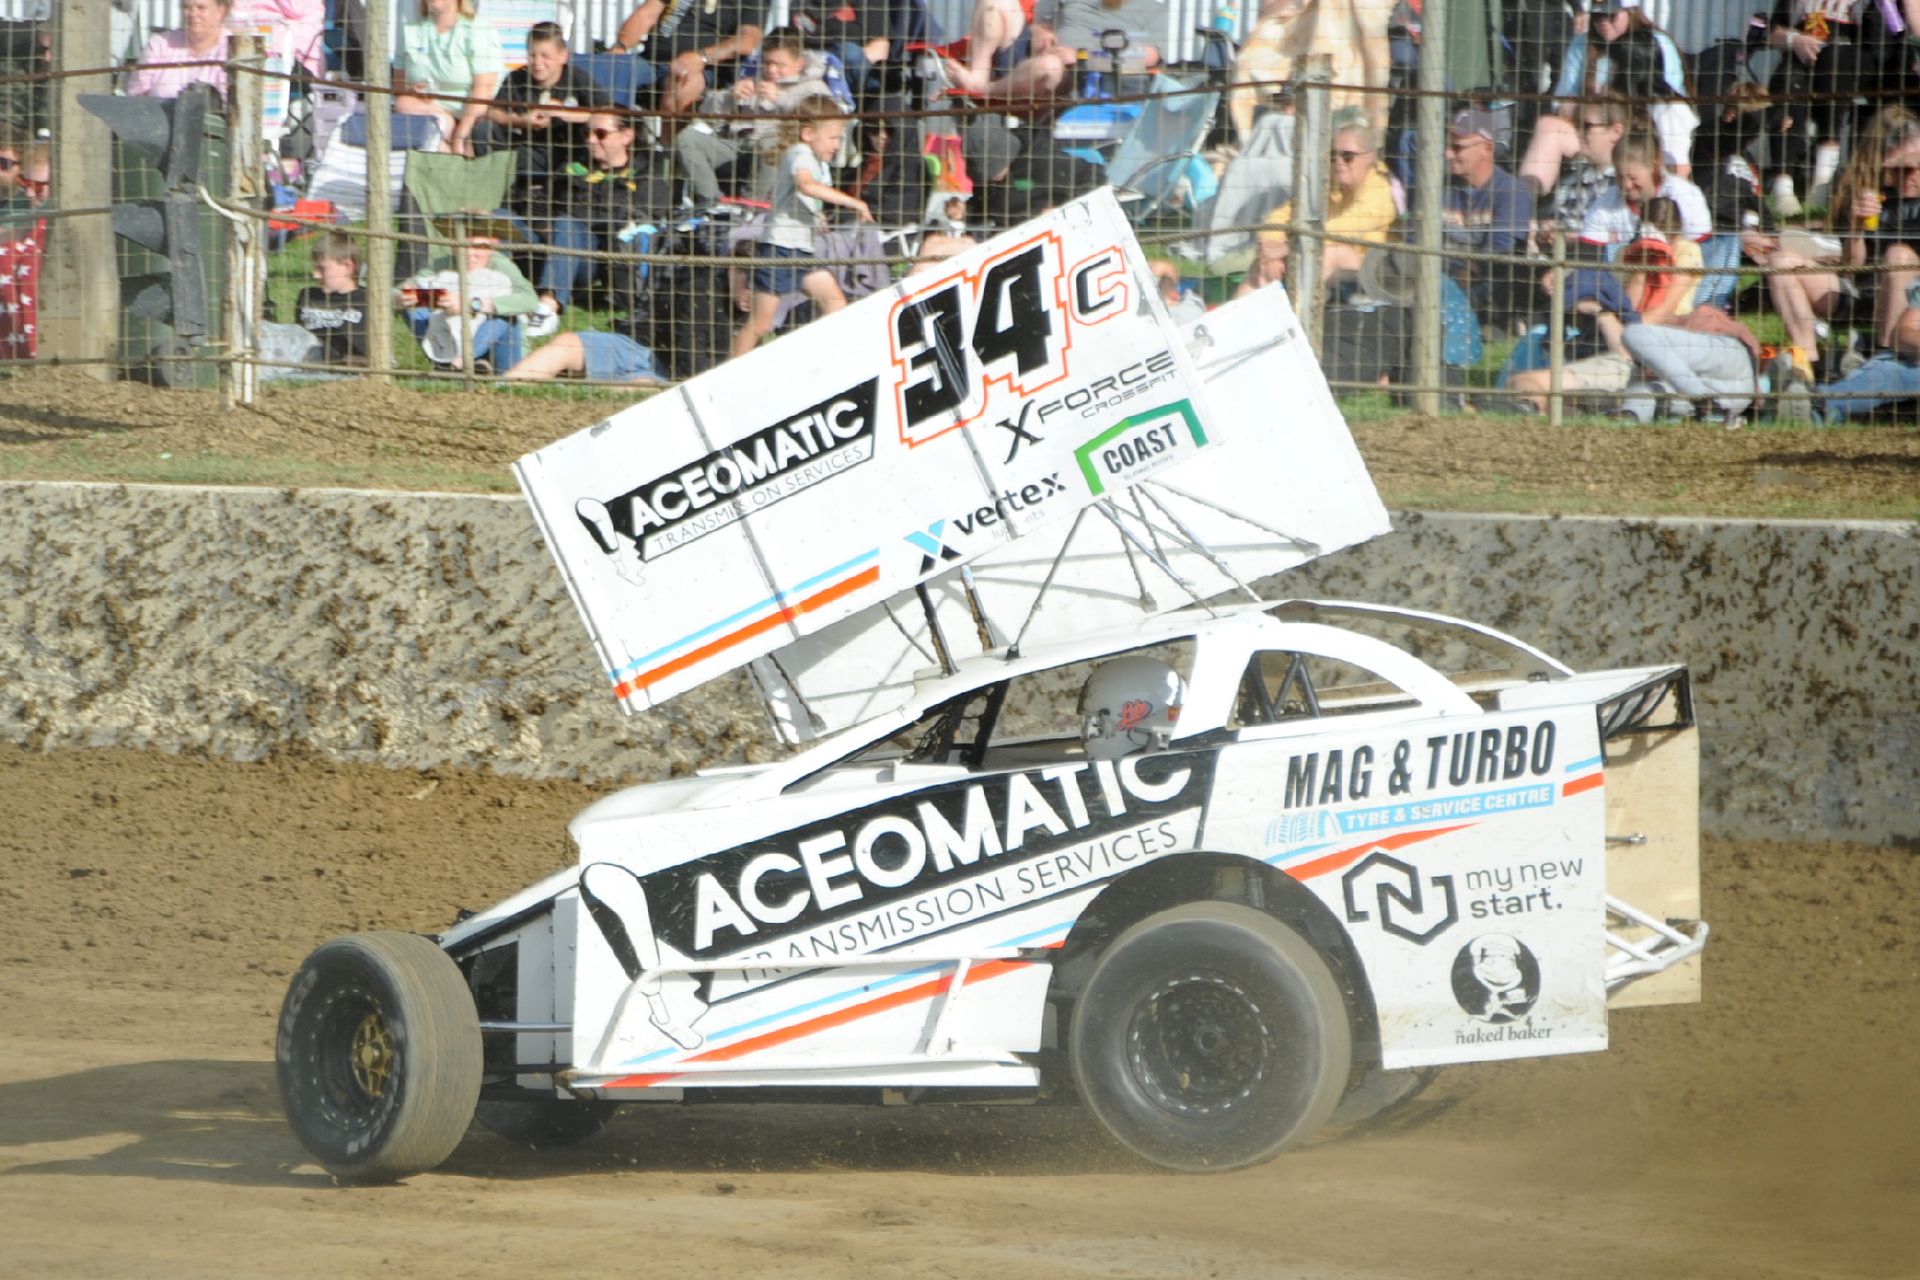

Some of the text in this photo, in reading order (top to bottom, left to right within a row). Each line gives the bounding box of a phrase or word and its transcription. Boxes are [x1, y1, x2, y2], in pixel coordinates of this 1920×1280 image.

[1081, 369, 1177, 418] CROSSFIT
[631, 401, 864, 537] ACEOMATIC
[1103, 422, 1178, 475] COAST
[654, 444, 863, 551] TRANSMISSON SERVICES
[953, 472, 1066, 536] vertex
[1284, 720, 1556, 809] MAG & TURBO
[1346, 787, 1550, 830] TYRE & SERVICE CENTRE
[695, 754, 1192, 950] ACEOMATIC
[1021, 821, 1177, 895] SERVICES
[1466, 857, 1583, 892] my new
[1470, 886, 1563, 919] start.
[1456, 1025, 1504, 1045] naked
[1508, 1025, 1553, 1041] baker
